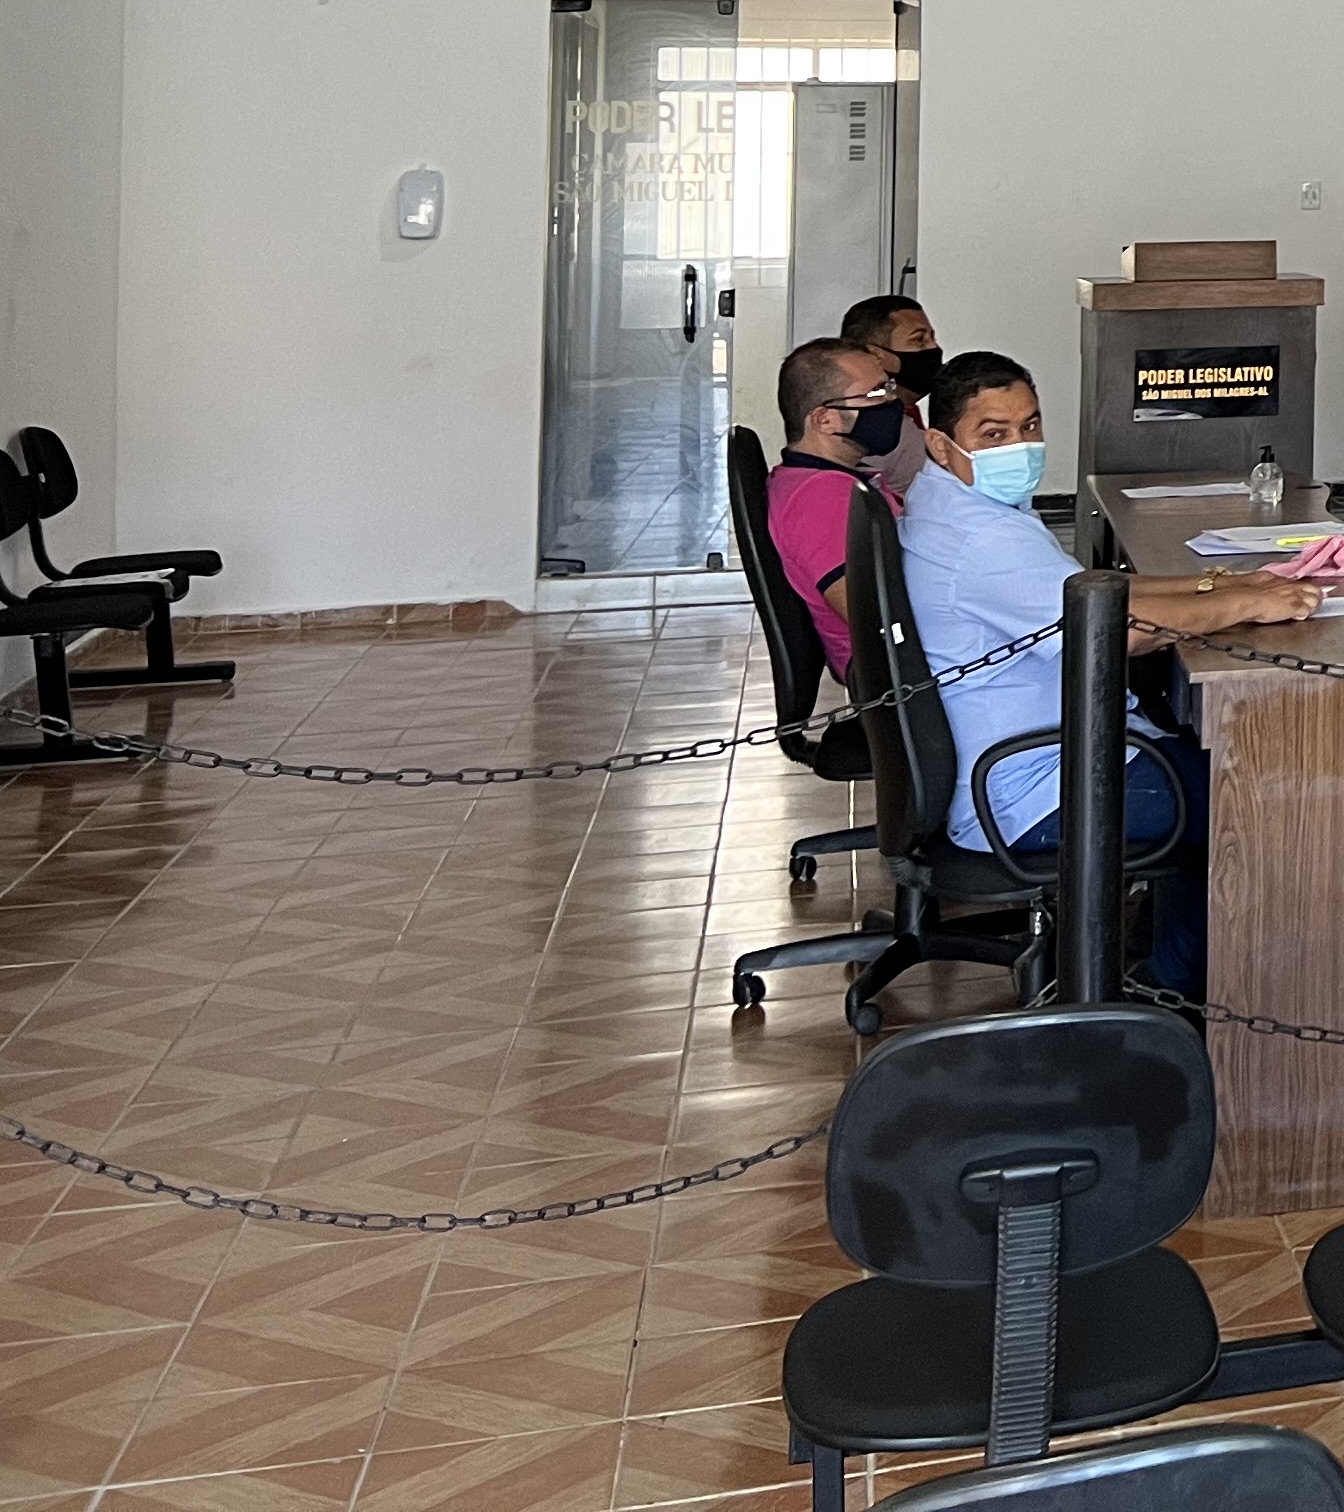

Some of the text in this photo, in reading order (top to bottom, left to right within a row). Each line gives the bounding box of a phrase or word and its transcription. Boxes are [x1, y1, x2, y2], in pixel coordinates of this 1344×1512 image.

[565, 100, 676, 134] PODER
[609, 180, 714, 203] MIGUEL
[1138, 365, 1274, 386] PODER LEGISLATIVO
[1142, 388, 1159, 400] SÃO
[1161, 389, 1193, 400] MIGUEL
[1194, 388, 1212, 399] DOS
